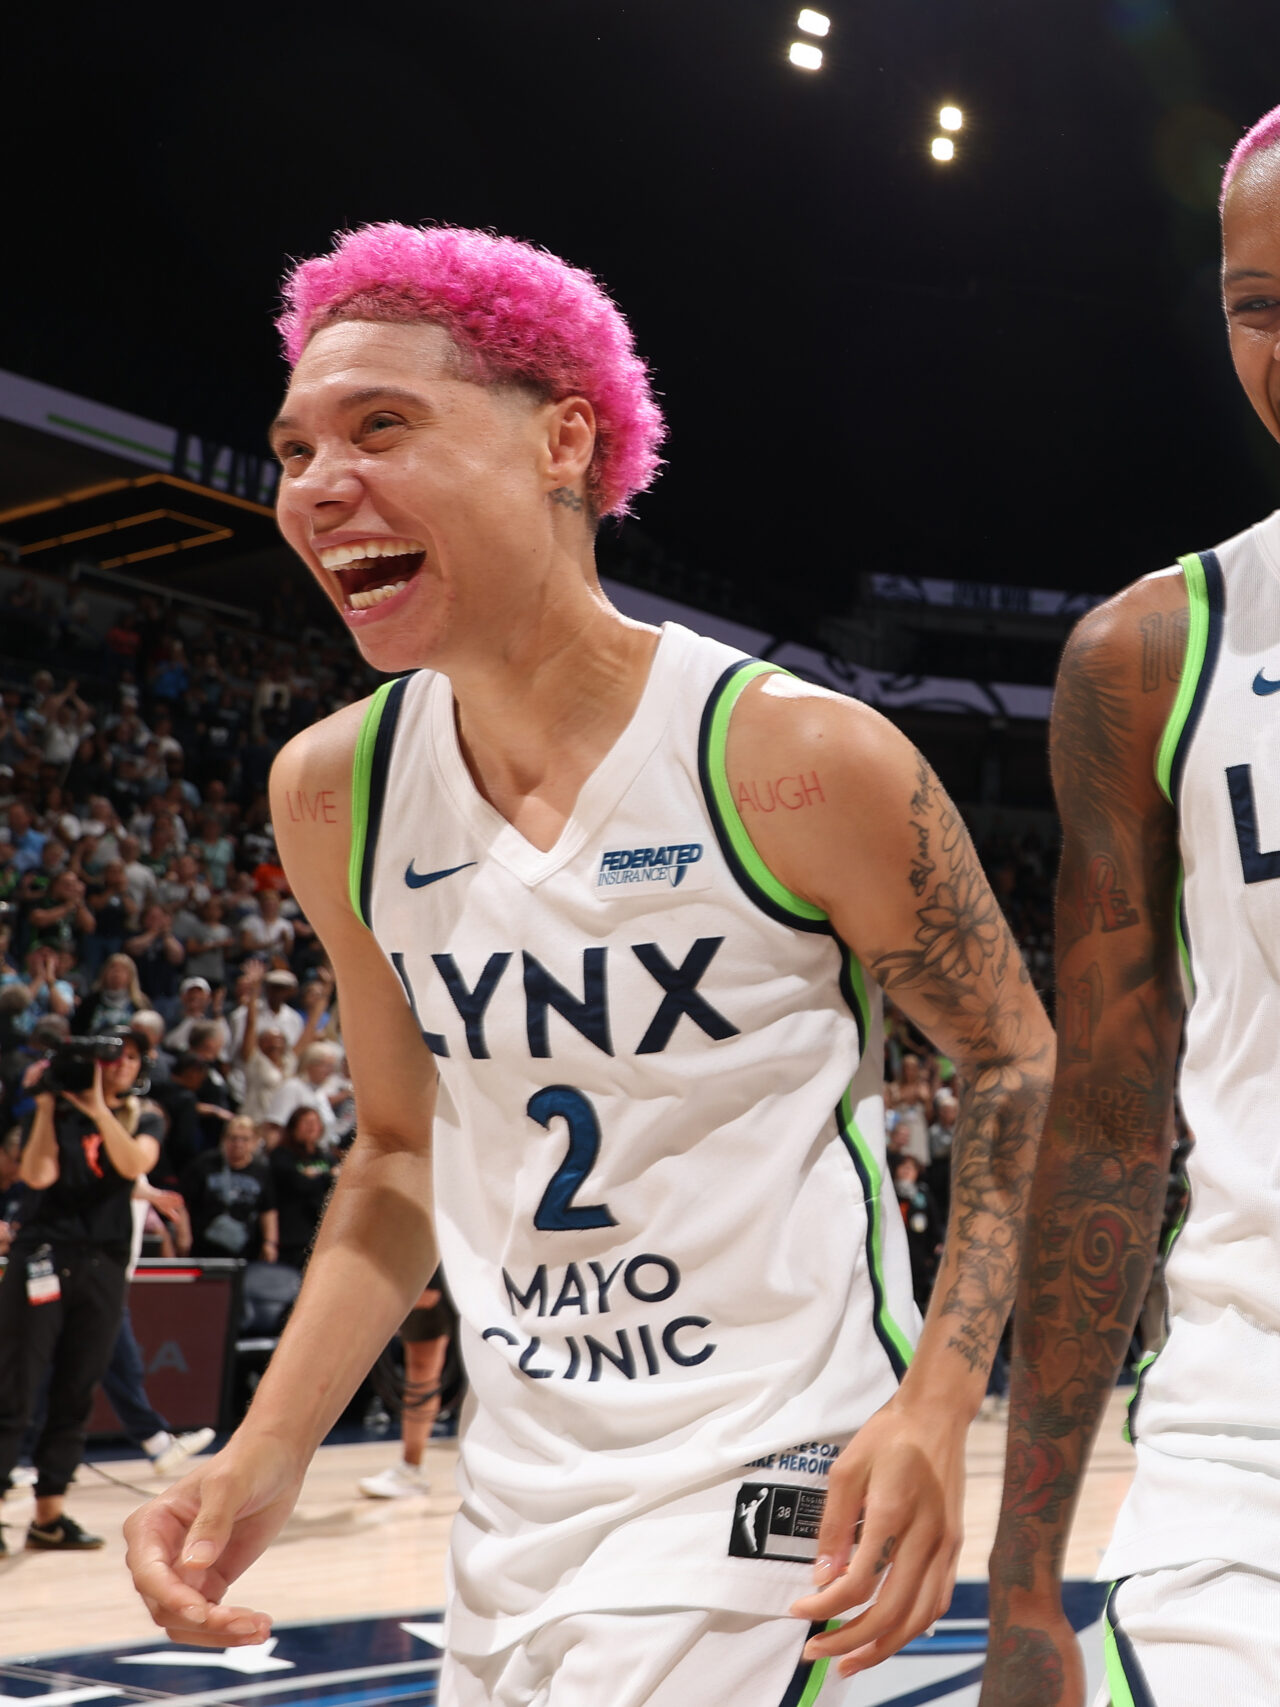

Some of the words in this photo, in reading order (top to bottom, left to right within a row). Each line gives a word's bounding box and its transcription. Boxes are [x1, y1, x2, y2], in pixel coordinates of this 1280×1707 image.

[285, 790, 337, 824] LIVE
[736, 770, 827, 813] AUGH
[601, 842, 704, 872] FEDERATED
[597, 867, 669, 887] INSURANCE
[526, 1084, 620, 1231] 2
[501, 1253, 681, 1317] MAYO
[778, 1454, 832, 1475] HEROIN
[776, 1505, 792, 1520] 38
